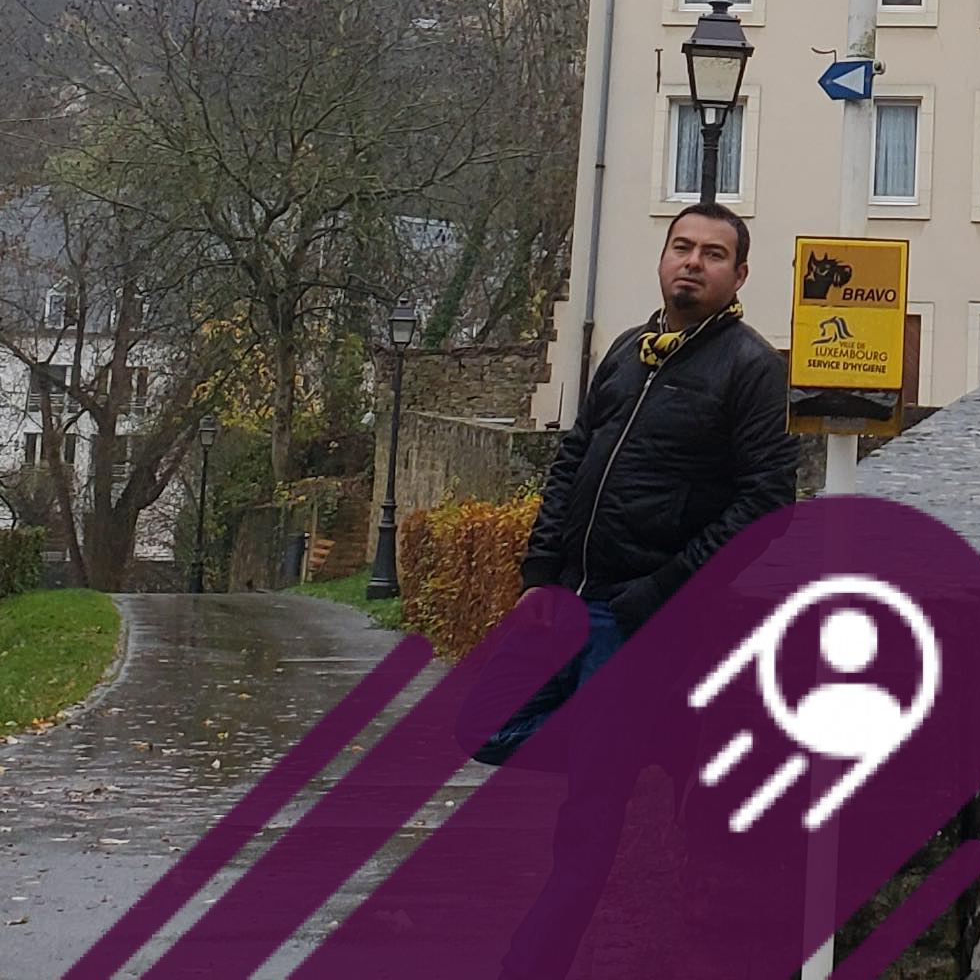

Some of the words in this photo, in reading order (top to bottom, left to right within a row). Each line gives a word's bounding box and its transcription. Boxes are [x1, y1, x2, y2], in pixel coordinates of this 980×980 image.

[842, 287, 896, 302] BRAVO
[815, 347, 888, 362] LUXEMBOURG
[807, 358, 840, 370] SERVICE
